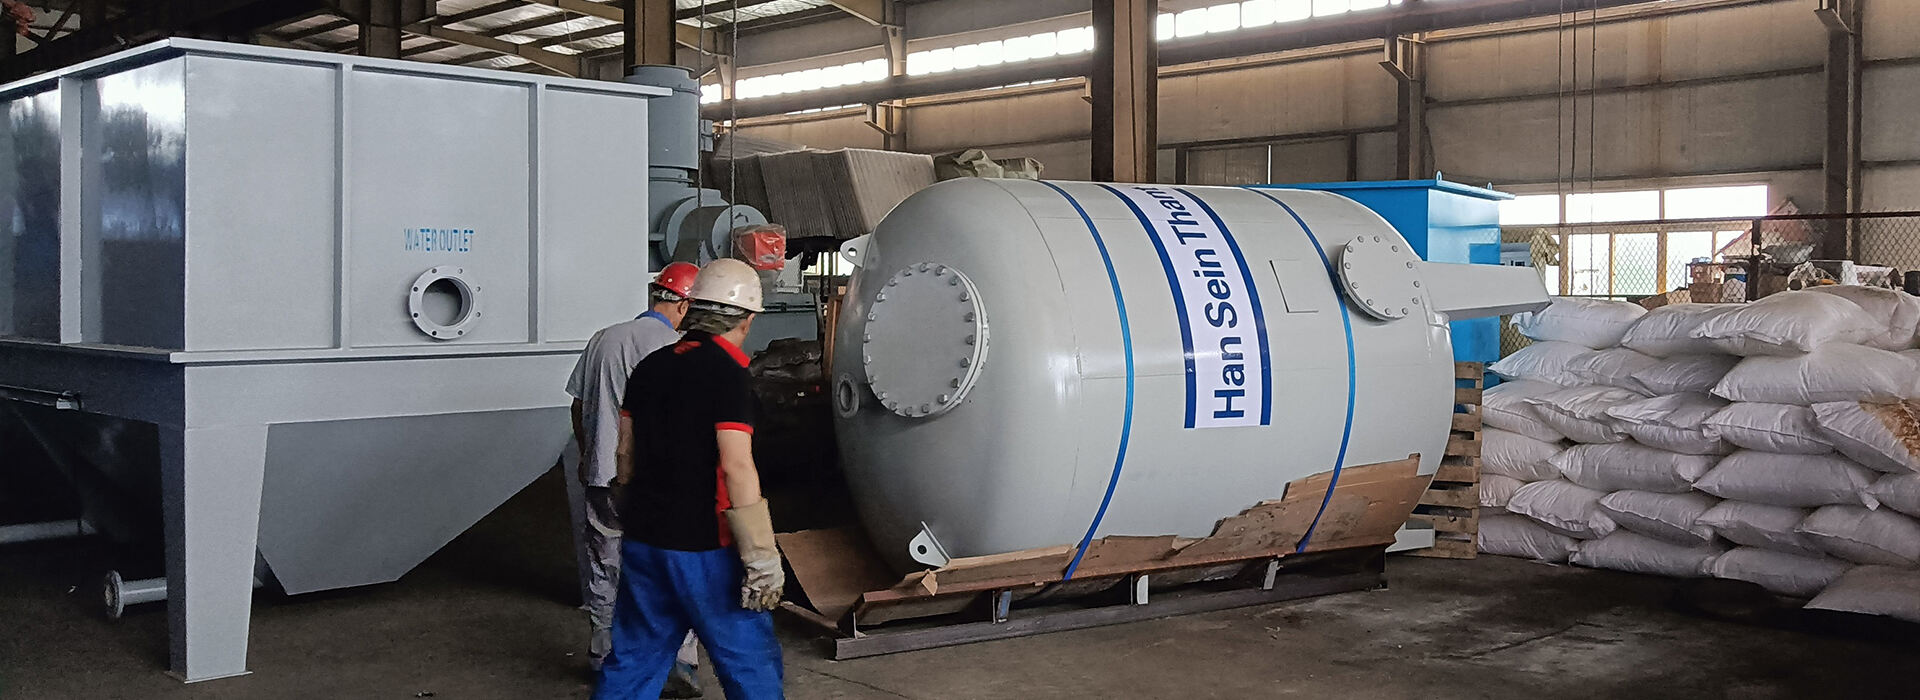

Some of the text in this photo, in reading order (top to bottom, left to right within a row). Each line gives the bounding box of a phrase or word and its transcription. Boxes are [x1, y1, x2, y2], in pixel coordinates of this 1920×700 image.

[404, 228, 474, 252] WATER OUTLET
[1192, 248, 1237, 329] Sein
[1212, 336, 1245, 419] Han
